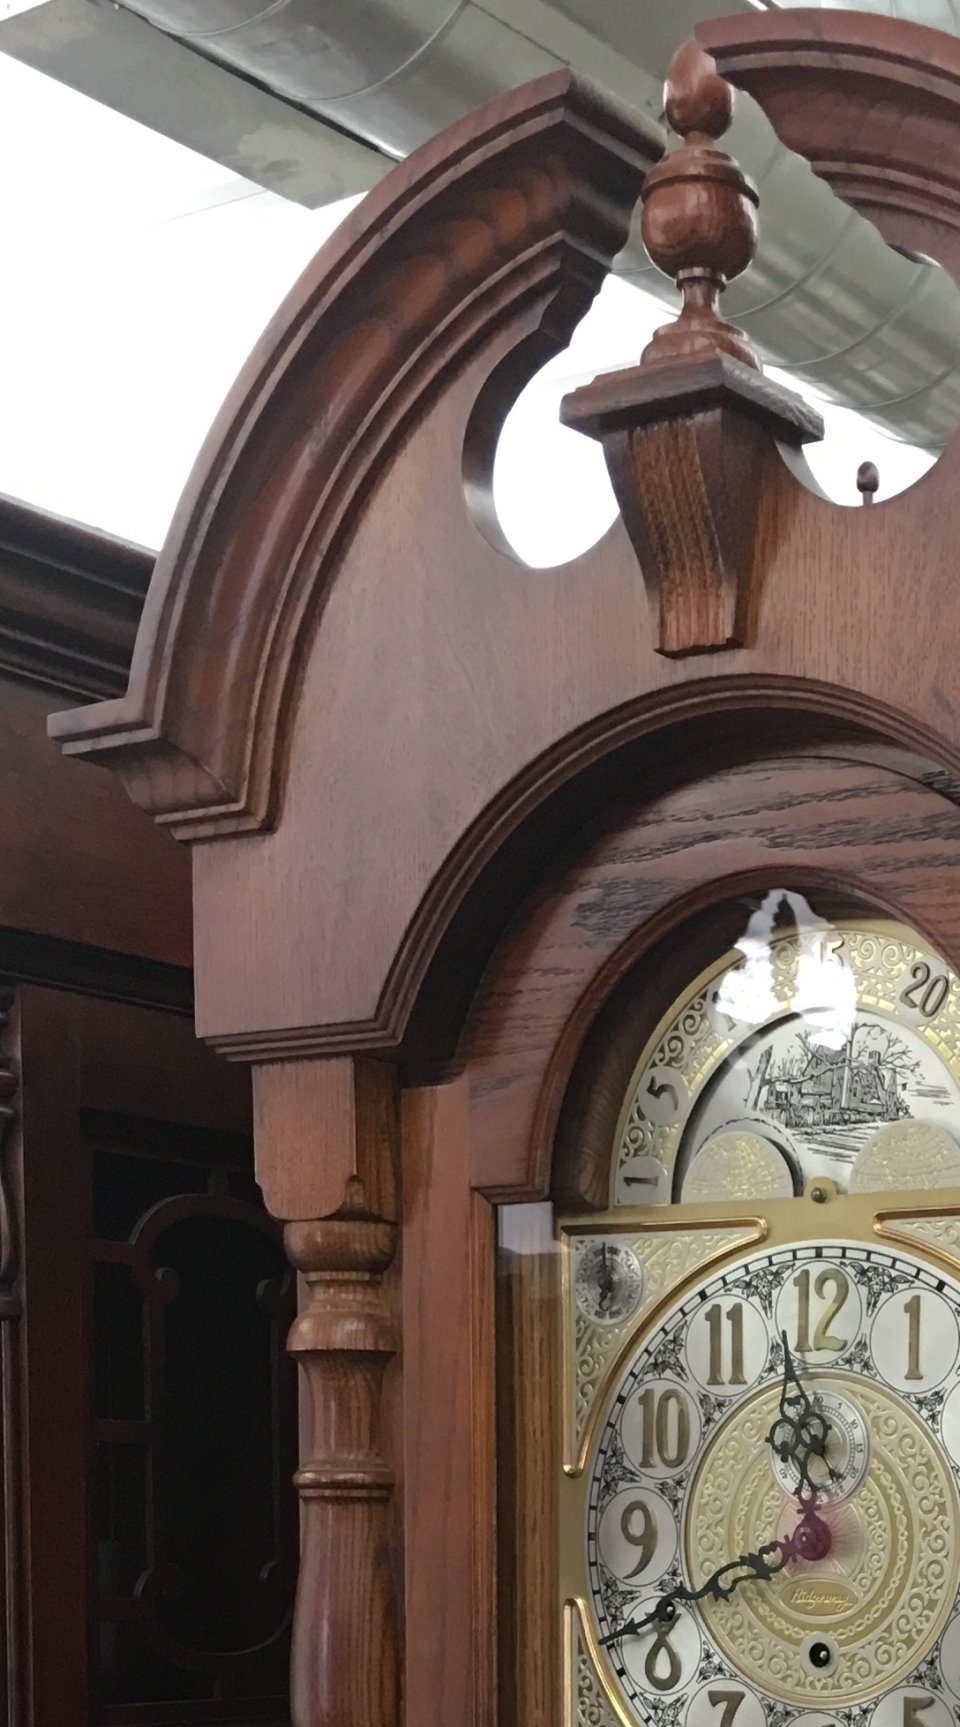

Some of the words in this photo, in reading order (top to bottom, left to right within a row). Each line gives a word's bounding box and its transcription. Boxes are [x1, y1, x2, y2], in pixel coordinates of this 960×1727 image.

[900, 961, 949, 1017] 20
[646, 1075, 679, 1111] 5
[623, 1175, 659, 1188] 1
[704, 1302, 747, 1386] 11
[794, 1268, 848, 1353] 12
[904, 1295, 924, 1381] 1
[637, 1387, 687, 1470] 10
[620, 1499, 658, 1581] 9
[643, 1606, 684, 1690] 8
